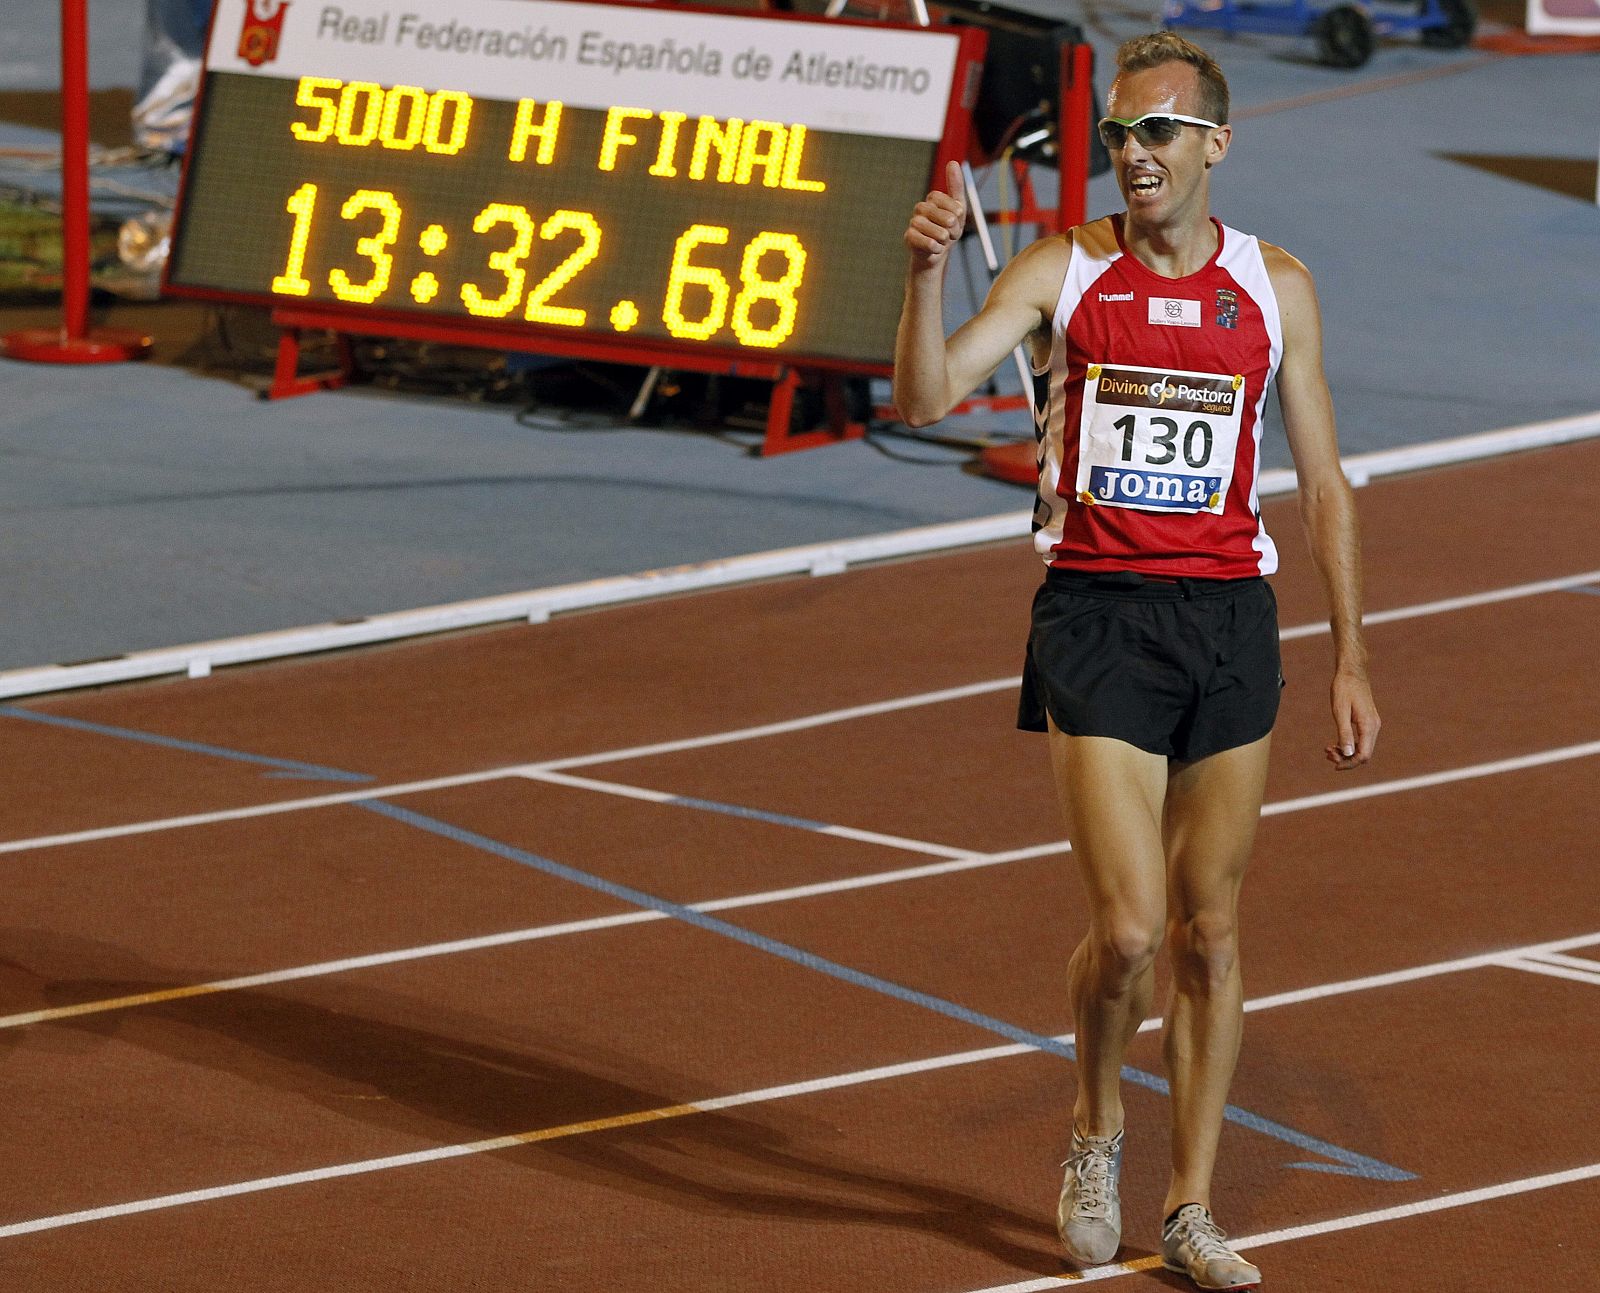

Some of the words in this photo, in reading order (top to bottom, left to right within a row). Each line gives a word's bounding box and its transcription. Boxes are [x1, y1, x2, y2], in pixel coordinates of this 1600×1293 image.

[317, 5, 389, 45] Real
[394, 13, 568, 61] Federación
[575, 31, 723, 75] Española
[731, 47, 772, 81] de
[779, 50, 931, 95] Atletismo
[291, 76, 473, 155] 5000
[509, 97, 562, 165] H
[598, 106, 826, 193] FINAL
[271, 183, 807, 349] 13:32.68
[1098, 291, 1134, 302] hummel
[1100, 377, 1148, 396] Divina
[1177, 384, 1233, 405] Pastora
[1112, 414, 1213, 469] 130
